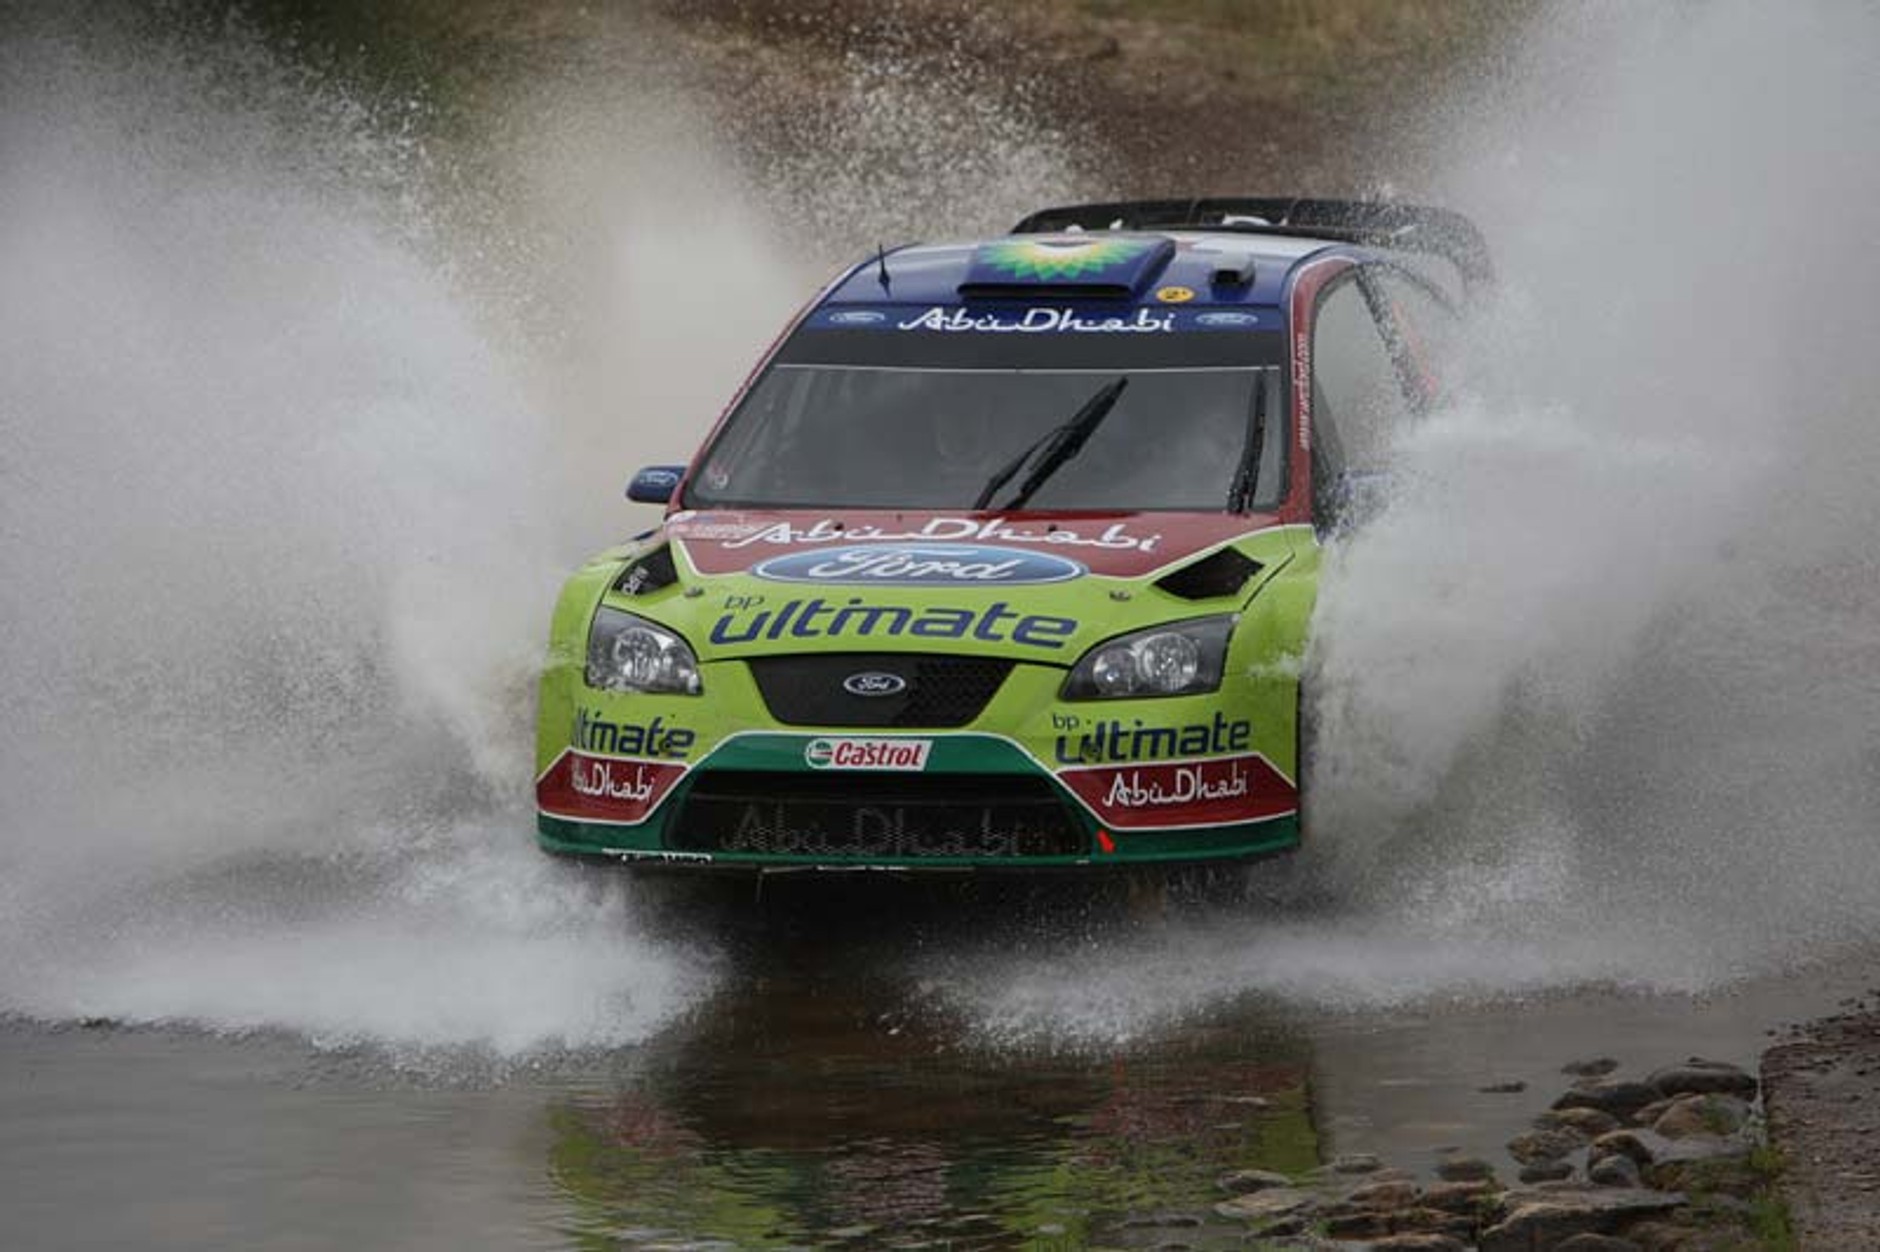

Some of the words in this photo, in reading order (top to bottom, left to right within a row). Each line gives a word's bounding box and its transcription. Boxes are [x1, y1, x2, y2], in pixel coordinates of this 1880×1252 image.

[808, 550, 1024, 579] Ford
[723, 595, 764, 610] bp
[709, 599, 1078, 648] ultimate
[857, 676, 891, 690] Ford
[1053, 713, 1080, 730] bp
[1056, 711, 1250, 763] ultimate
[834, 742, 921, 766] Castrol
